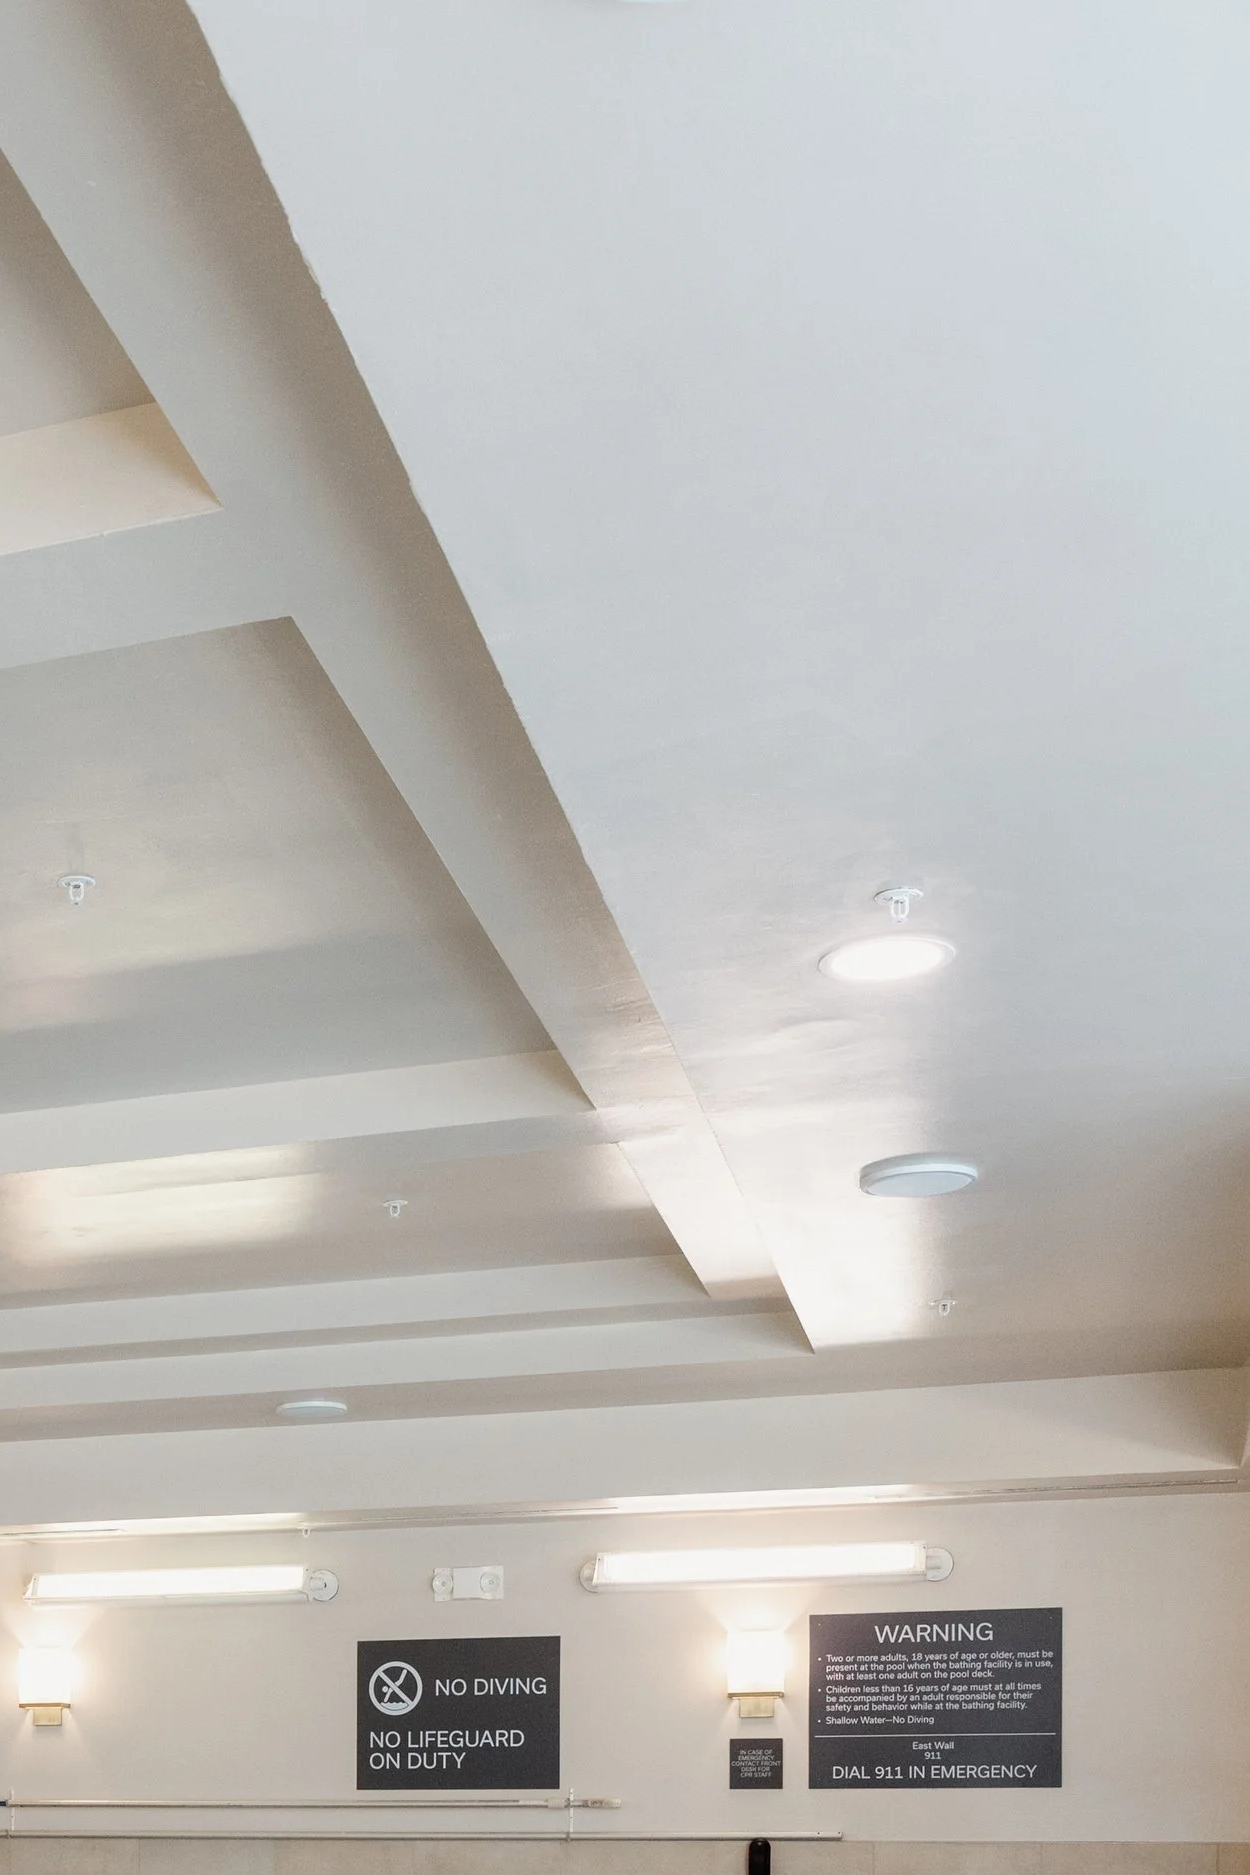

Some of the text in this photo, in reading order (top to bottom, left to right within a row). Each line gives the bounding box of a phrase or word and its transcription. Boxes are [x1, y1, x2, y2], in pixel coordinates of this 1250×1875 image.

[874, 1622, 993, 1643] WARNING
[826, 1654, 843, 1662] Two
[880, 1653, 908, 1662] adults,
[925, 1654, 947, 1662] years
[961, 1653, 977, 1662] age
[990, 1651, 1014, 1659] older,
[1042, 1650, 1053, 1658] be
[826, 1664, 858, 1673] present
[886, 1662, 905, 1671] pool
[907, 1662, 930, 1670] when
[949, 1660, 981, 1670] bathing
[984, 1660, 1013, 1669] facility
[1025, 1659, 1032, 1667] in
[1035, 1660, 1053, 1668] use,
[826, 1673, 844, 1681] with
[857, 1672, 876, 1680] least
[897, 1671, 918, 1679] adult
[950, 1670, 969, 1679] pool
[972, 1669, 995, 1677] deck.
[435, 1677, 547, 1696] NO DIVING
[826, 1685, 860, 1693] Children
[863, 1685, 879, 1693] less
[916, 1685, 938, 1693] years
[941, 1684, 950, 1692] of
[970, 1683, 992, 1691] must
[1005, 1682, 1015, 1690] all
[839, 1694, 894, 1703] accompanied
[897, 1694, 907, 1703] by
[922, 1693, 944, 1701] adult
[946, 1693, 996, 1701] responsible
[826, 1704, 851, 1712] safety
[910, 1702, 932, 1710] while
[962, 1701, 994, 1710] bathing
[997, 1701, 1027, 1710] facility.
[826, 1716, 858, 1725] Shallow
[908, 1715, 934, 1724] Diving
[370, 1730, 525, 1748] NO LIFEGUARD
[912, 1741, 954, 1750] East Wall
[369, 1752, 466, 1770] ON DUTY
[925, 1751, 941, 1760] 911
[832, 1764, 1037, 1779] DIAL 911 IN EMERGENCY
